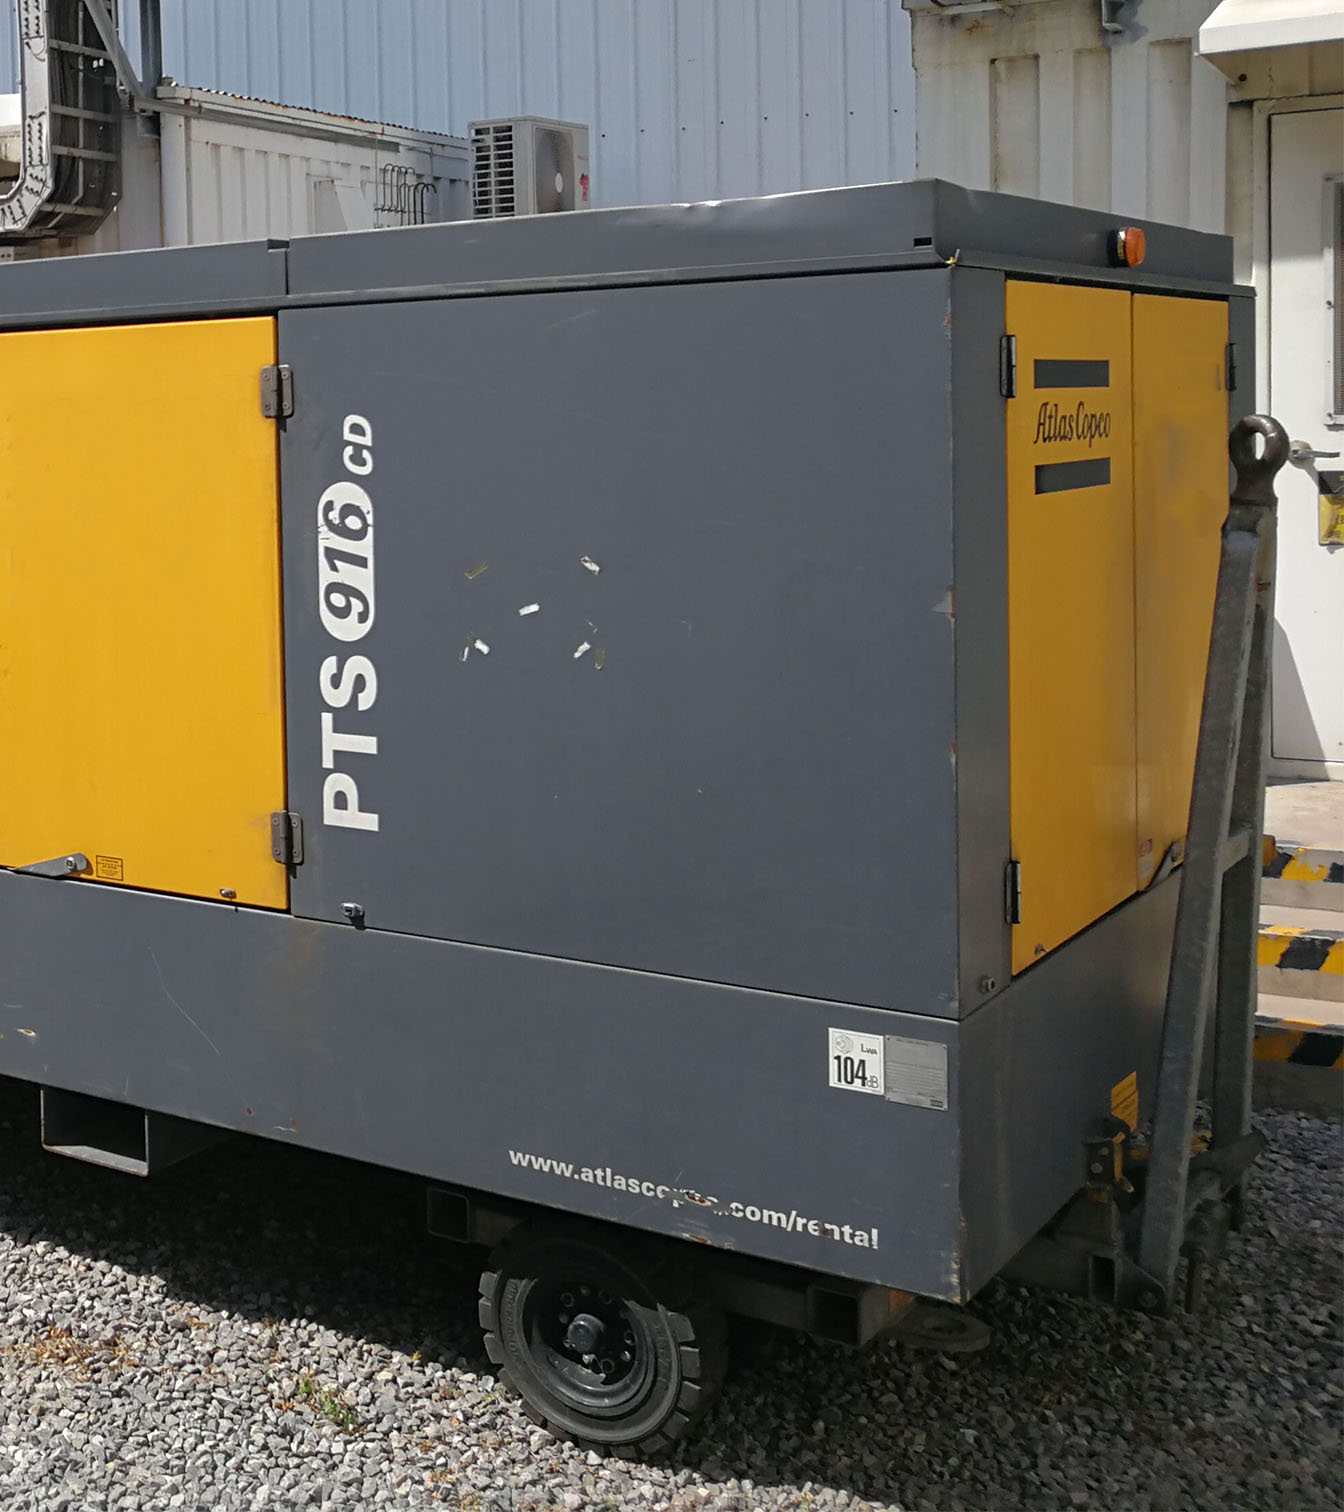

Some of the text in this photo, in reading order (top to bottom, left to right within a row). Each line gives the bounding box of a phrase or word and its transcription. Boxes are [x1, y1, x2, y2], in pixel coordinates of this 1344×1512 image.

[1033, 400, 1111, 448] Atlas Copco
[319, 414, 379, 832] PTS 916 CD
[833, 1054, 880, 1089] 104 dB
